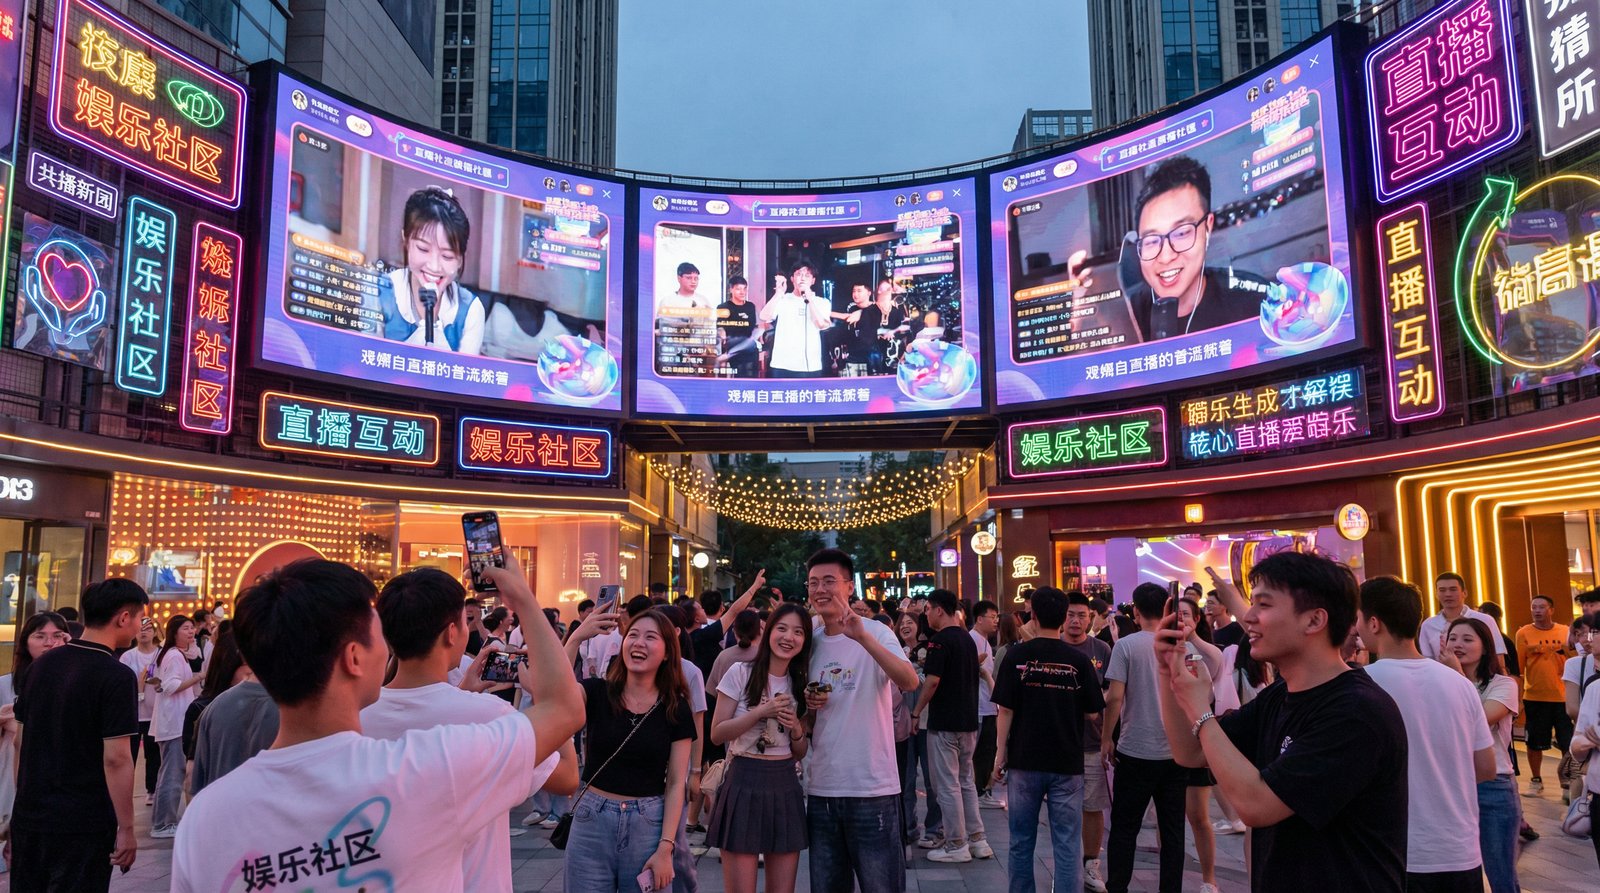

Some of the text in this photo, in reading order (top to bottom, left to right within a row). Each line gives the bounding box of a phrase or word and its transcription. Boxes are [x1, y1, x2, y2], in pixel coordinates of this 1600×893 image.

[1381, 4, 1493, 116] 直播
[75, 78, 222, 184] 娱乐社区
[1388, 74, 1500, 181] 互动
[37, 162, 113, 212] 共播新团
[128, 211, 167, 382] 娱乐社区
[1386, 218, 1435, 407] 直播互动
[278, 405, 425, 456] 直播互动
[469, 427, 601, 468] 娱乐社区
[1021, 421, 1151, 466] 娱乐社区
[241, 828, 381, 893] 娱乐社区
